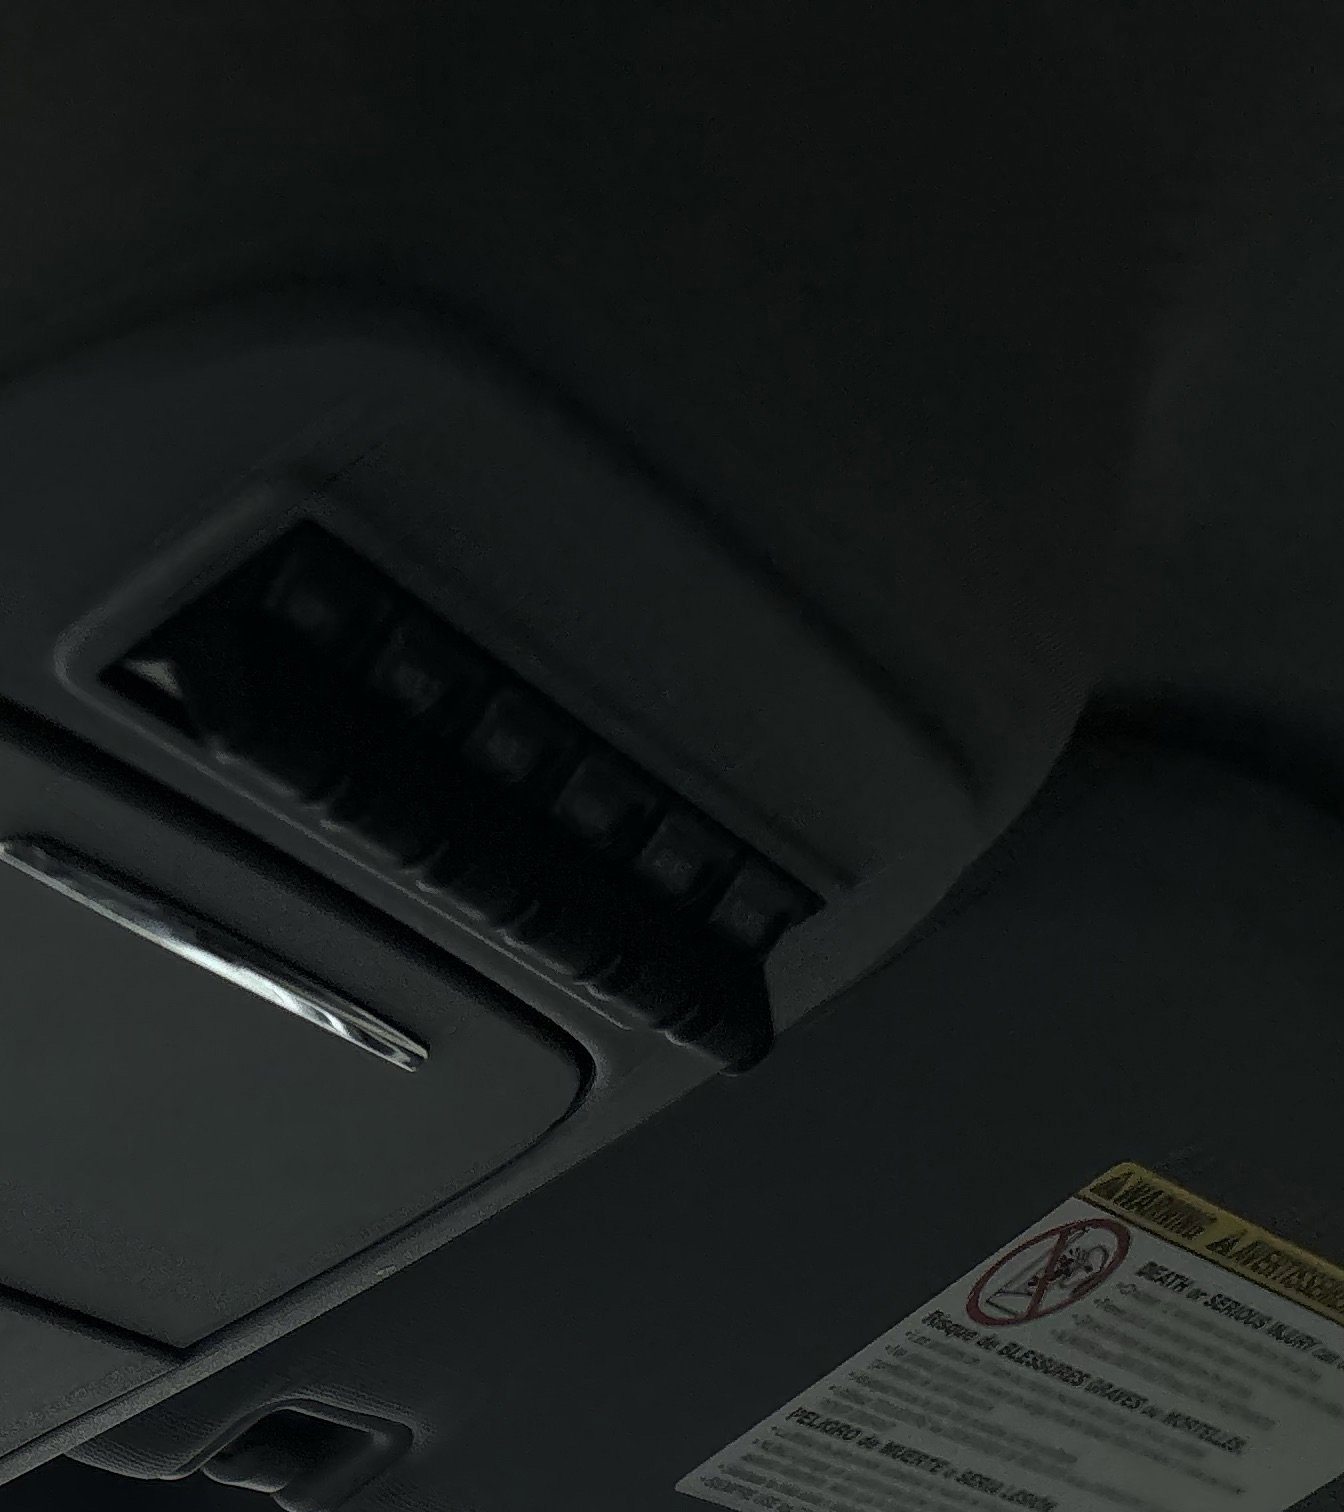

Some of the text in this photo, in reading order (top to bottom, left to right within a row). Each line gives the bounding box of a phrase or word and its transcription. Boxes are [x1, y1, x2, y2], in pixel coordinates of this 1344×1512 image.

[1135, 1261, 1196, 1293] DEATH
[1203, 1293, 1272, 1330] SERIOUS
[1266, 1319, 1324, 1351] INJURY
[924, 1308, 980, 1345] Risque
[977, 1330, 999, 1352] de
[996, 1340, 1092, 1390] BLESSURES
[1084, 1376, 1149, 1410] GRAVES
[786, 1407, 863, 1445] PELIGRO
[877, 1438, 946, 1475] MUERTE
